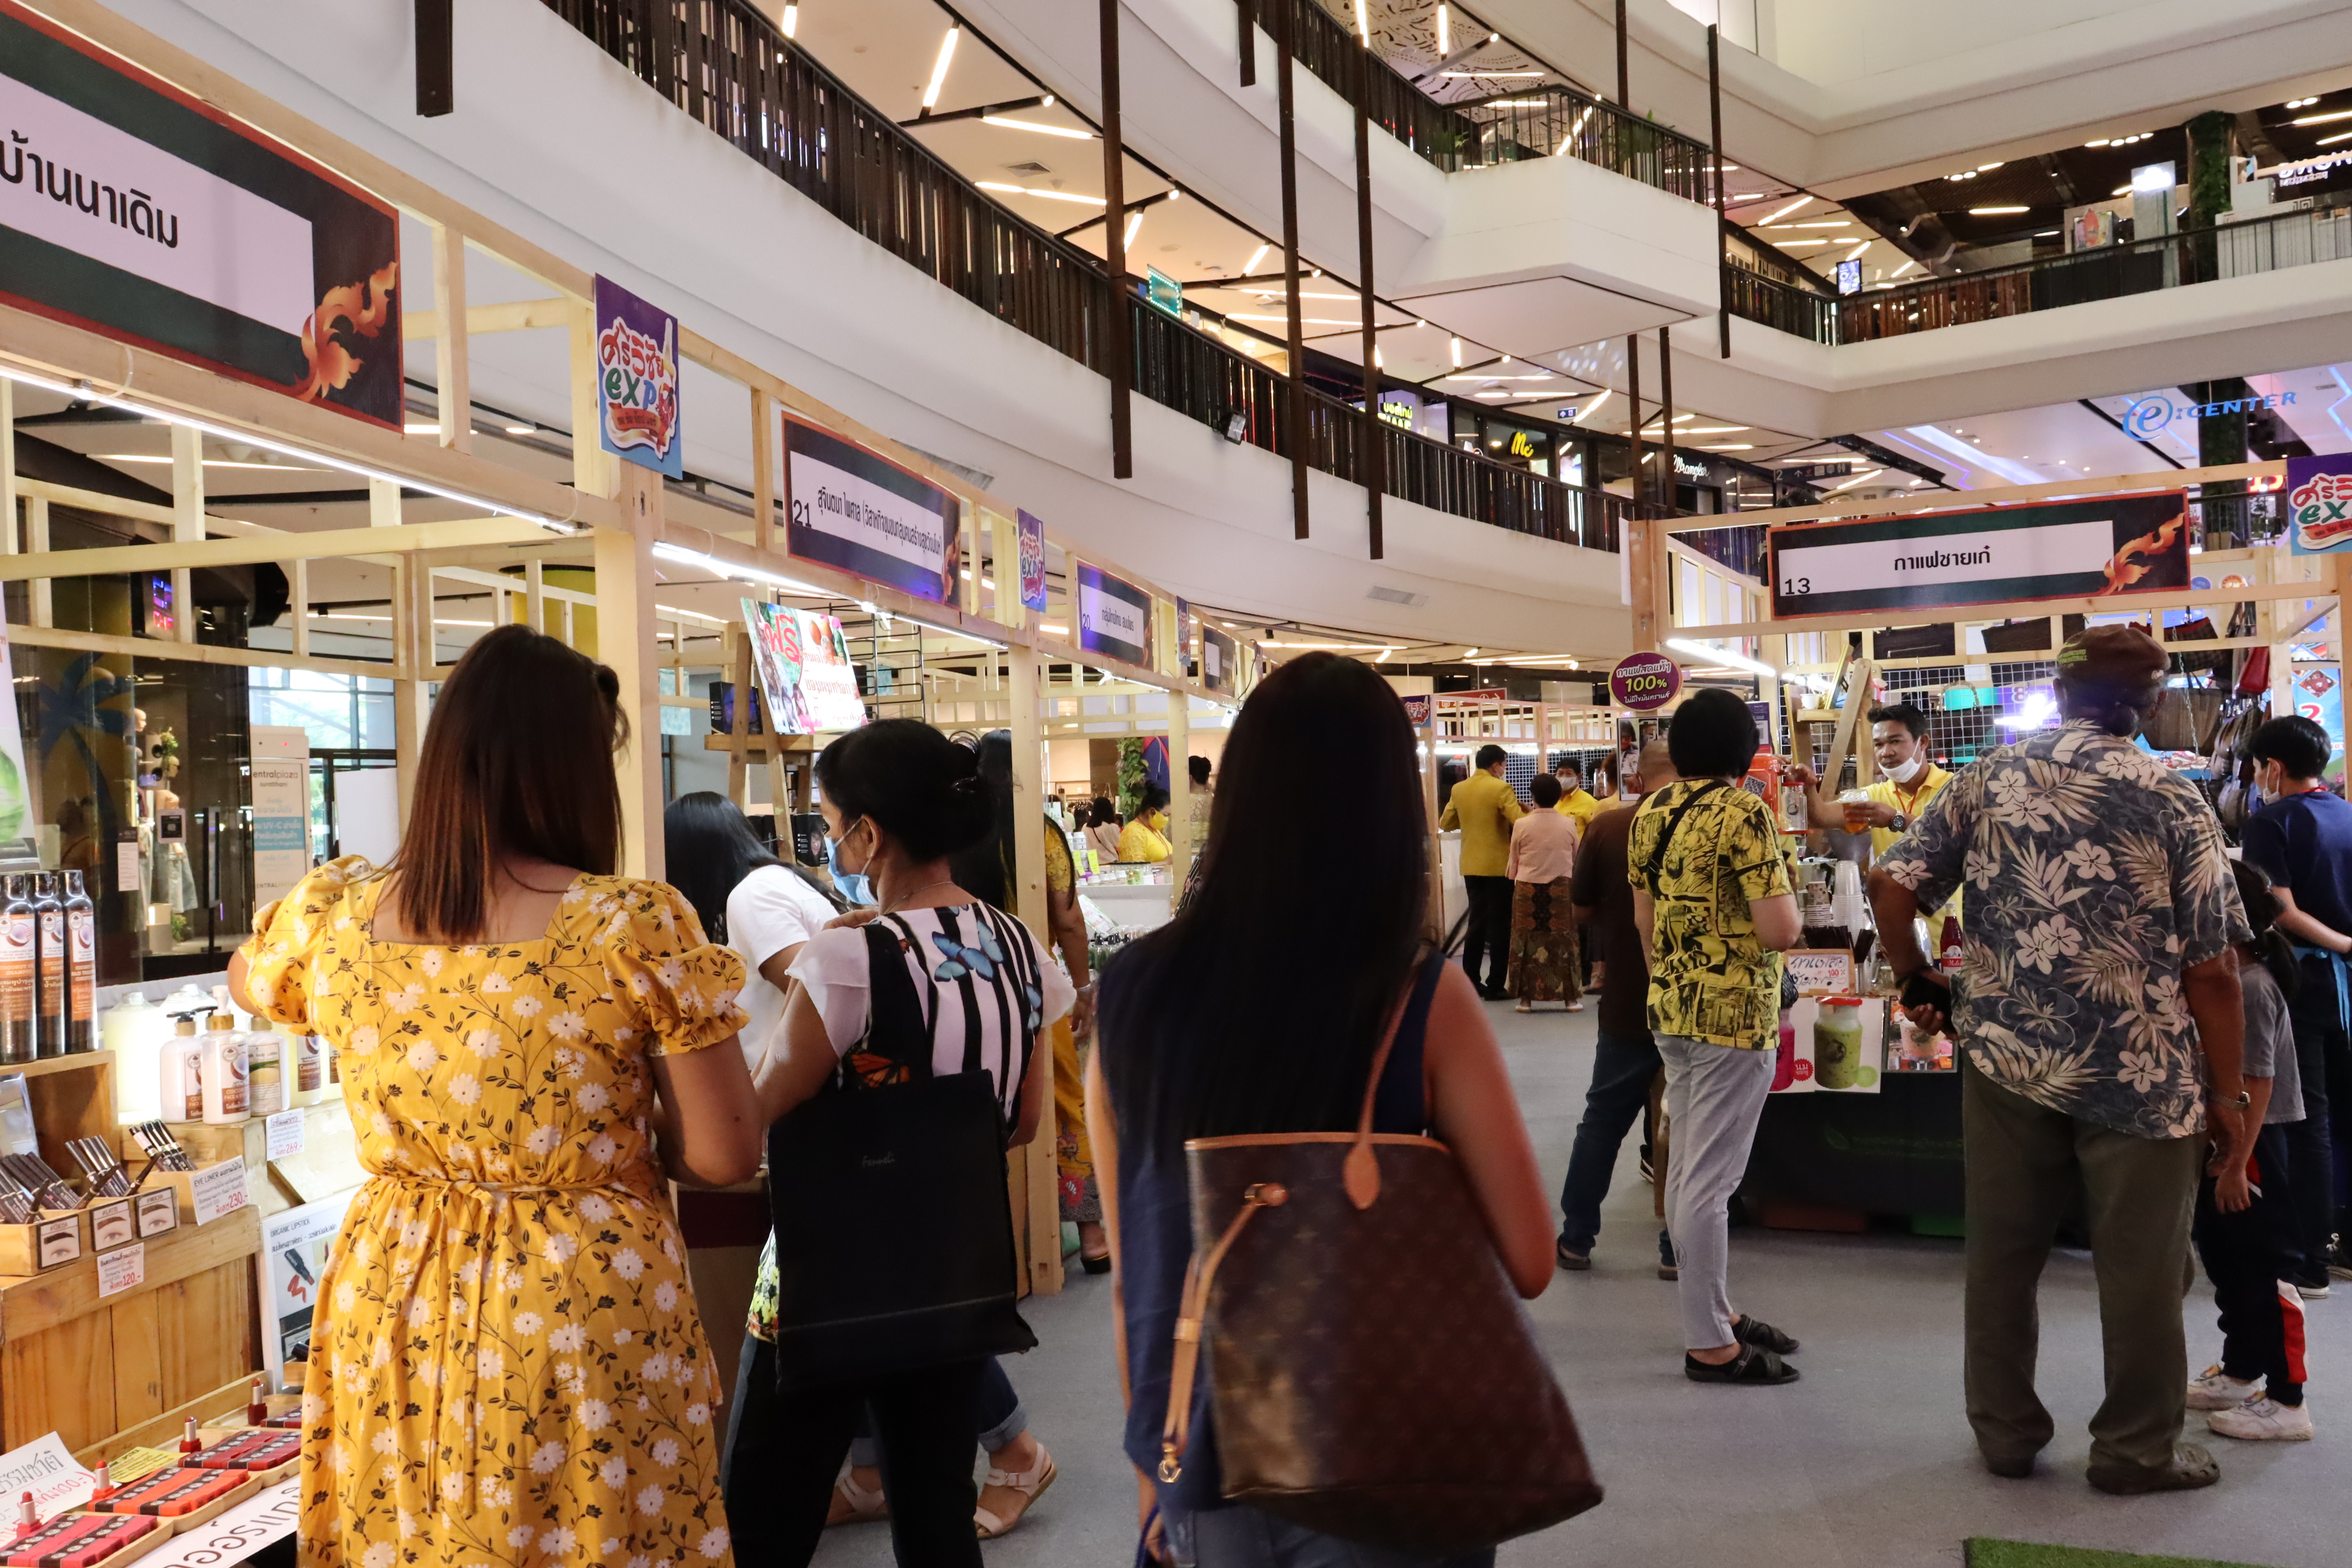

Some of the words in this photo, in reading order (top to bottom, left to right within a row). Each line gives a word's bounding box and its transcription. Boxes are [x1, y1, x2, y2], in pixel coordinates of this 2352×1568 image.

[1673, 454, 1710, 482] Wrangler
[1776, 469, 1783, 481] 2
[793, 499, 812, 528] 21
[1894, 545, 1991, 571] กาแฟชายเก๋
[1785, 577, 1811, 596] 13
[1082, 613, 1090, 630] 20
[1625, 675, 1667, 692] 100%
[253, 769, 298, 782] entralplaza
[286, 1142, 303, 1154] 269.-
[194, 1178, 204, 1187] EYE
[205, 1171, 220, 1184] LINER
[228, 1191, 248, 1208] 230.-
[270, 1225, 290, 1237] ORGANIC
[291, 1218, 311, 1230] LIPSTICK
[123, 1272, 141, 1286] 120.-
